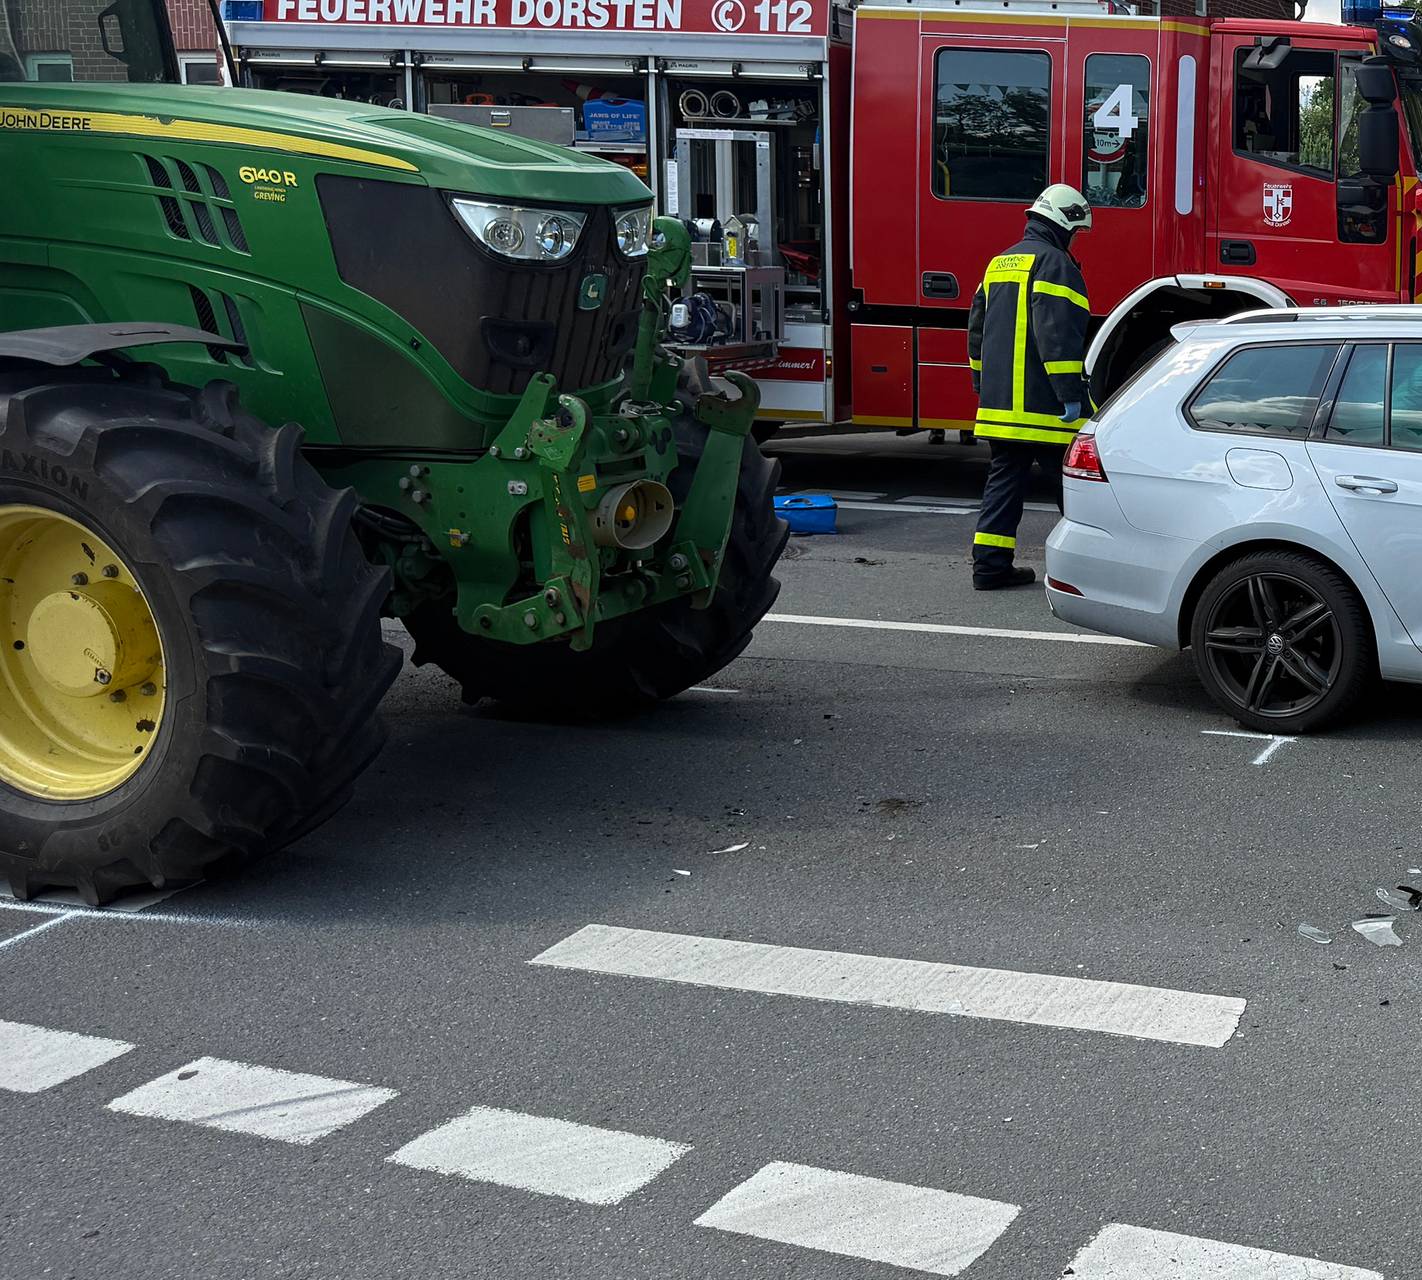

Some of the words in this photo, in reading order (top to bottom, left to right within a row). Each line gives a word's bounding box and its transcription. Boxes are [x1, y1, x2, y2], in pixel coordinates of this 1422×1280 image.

[277, 0, 496, 25] FEUERWEHR
[510, 0, 681, 29] DORSTEN
[754, 0, 812, 32] 112
[0, 112, 37, 128] JOHN
[40, 113, 91, 130] DEERE
[1094, 84, 1138, 138] 4
[254, 192, 286, 202] GREVING
